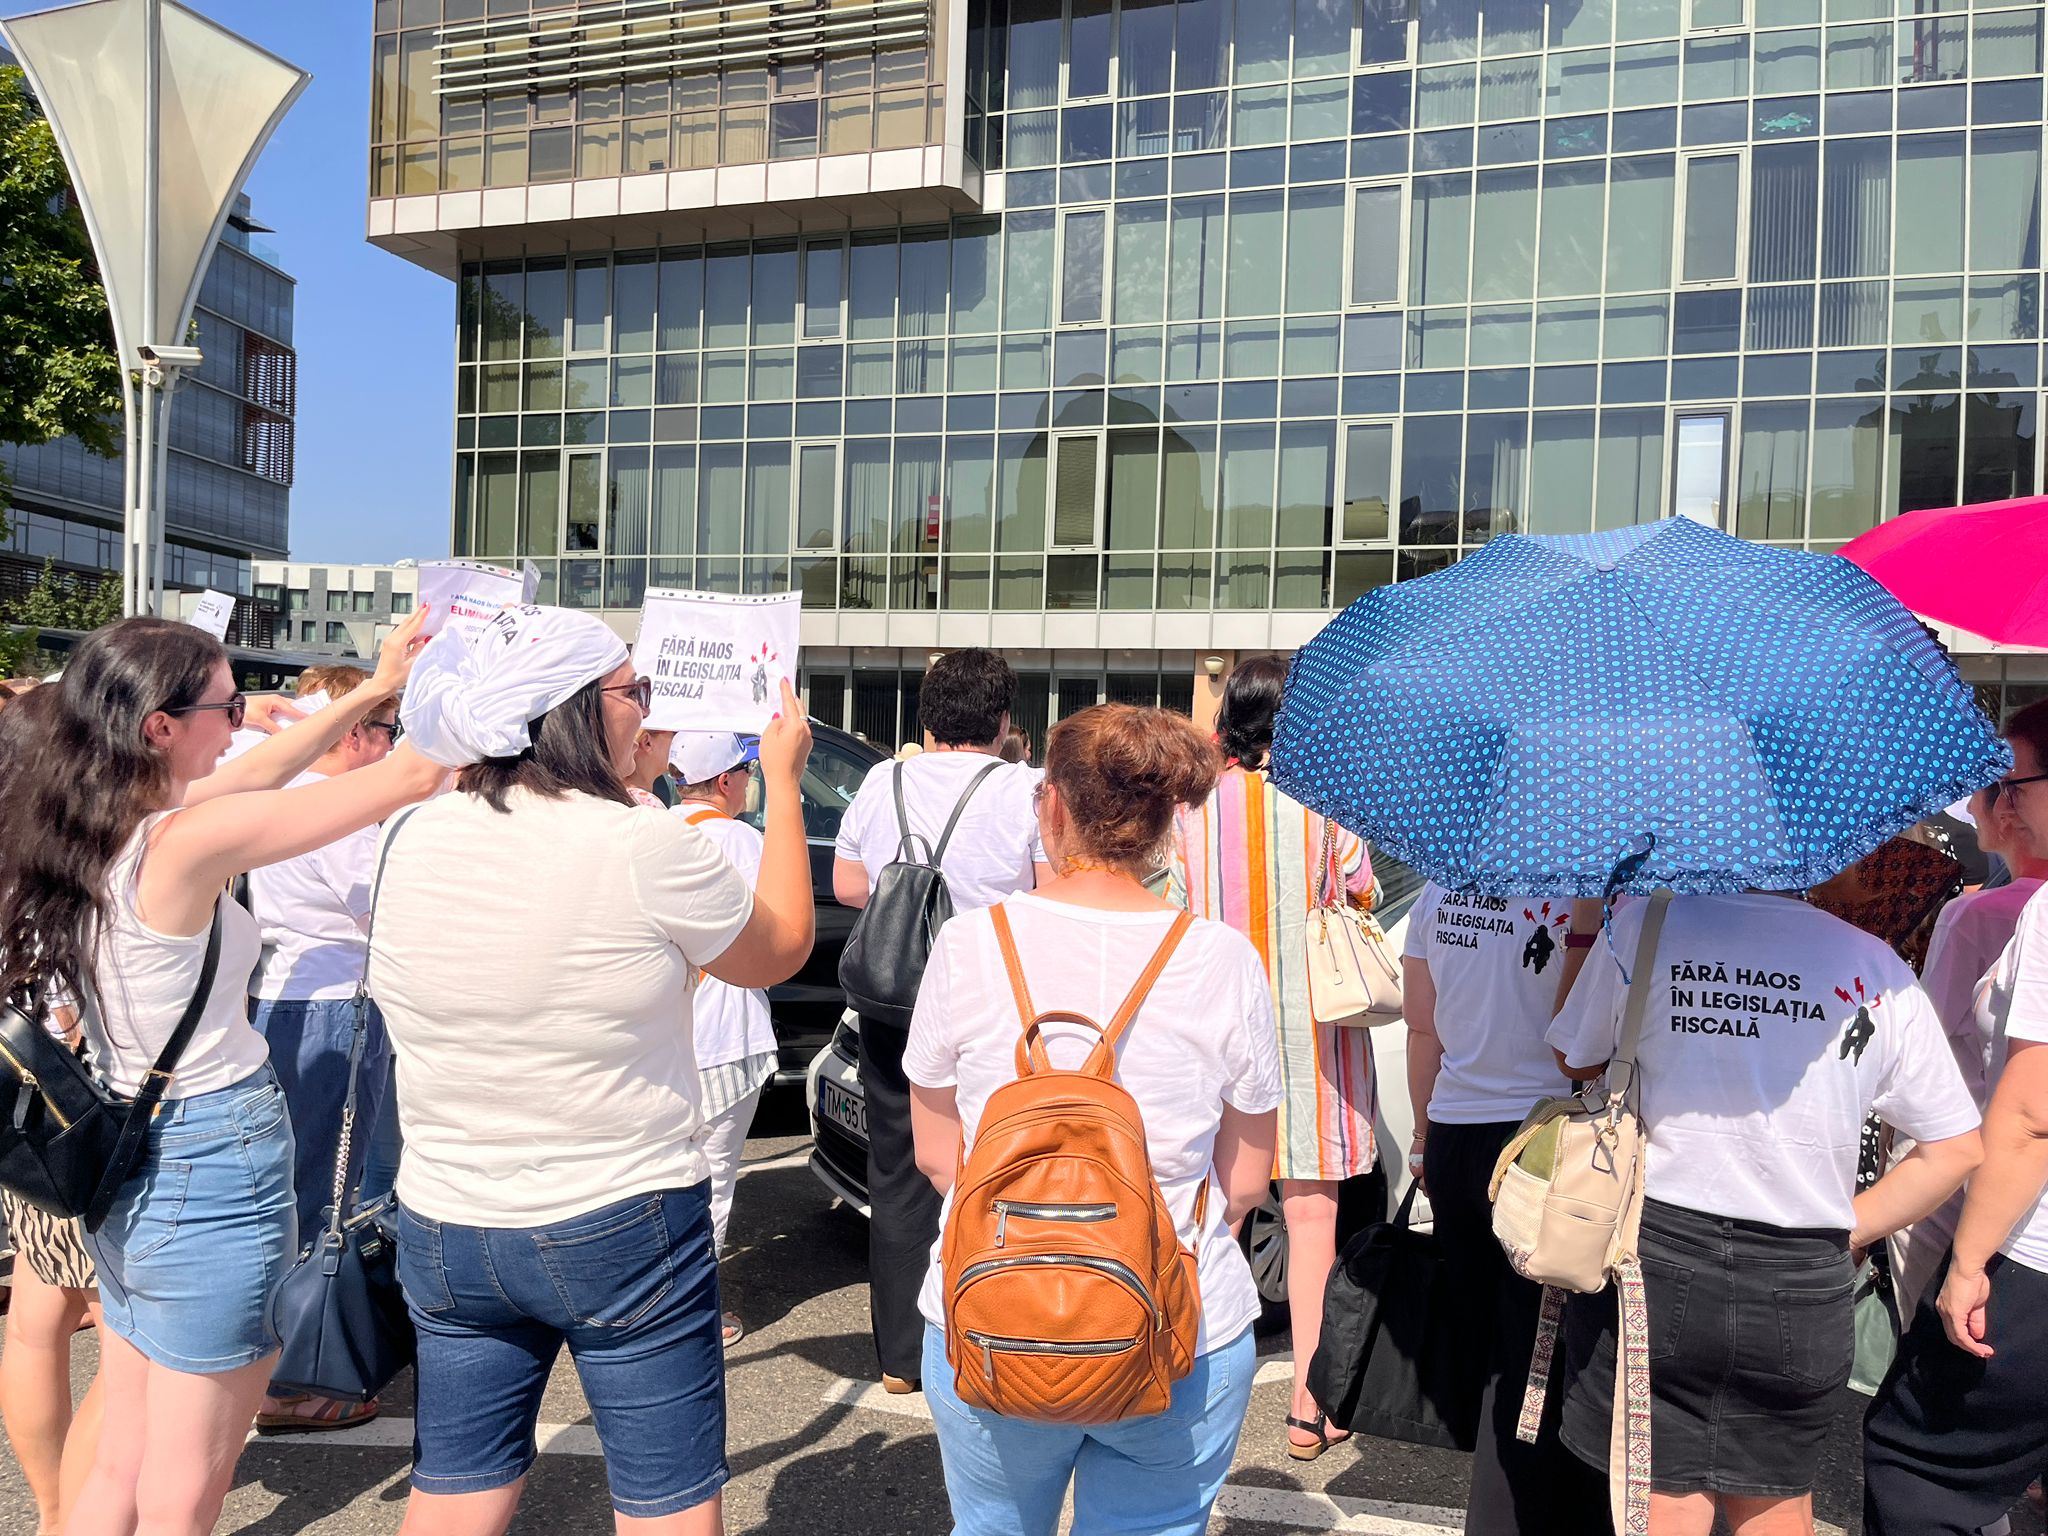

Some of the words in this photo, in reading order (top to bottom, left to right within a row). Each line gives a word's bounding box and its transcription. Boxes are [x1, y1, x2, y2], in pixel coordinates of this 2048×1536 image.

[660, 634, 696, 657] FĂRĂ
[698, 641, 734, 660] HAOS
[656, 655, 671, 676] ÎN
[673, 660, 742, 685] LEGISLAȚIA
[651, 680, 705, 700] FISCALĂ
[1472, 895, 1508, 912] HAOS
[1437, 907, 1449, 924] ÎN
[1450, 911, 1514, 936] LEGISLAȚIA
[1436, 930, 1479, 949] FISCALĂ
[1671, 960, 1728, 983] FĂRĂ
[1736, 968, 1801, 991] HAOS
[1670, 985, 1693, 1007] ÎN
[1701, 991, 1825, 1023] LEGISLAȚIA
[1671, 1016, 1760, 1039] FISCALĂ
[827, 1085, 841, 1120] TM
[845, 1097, 859, 1129] 65
